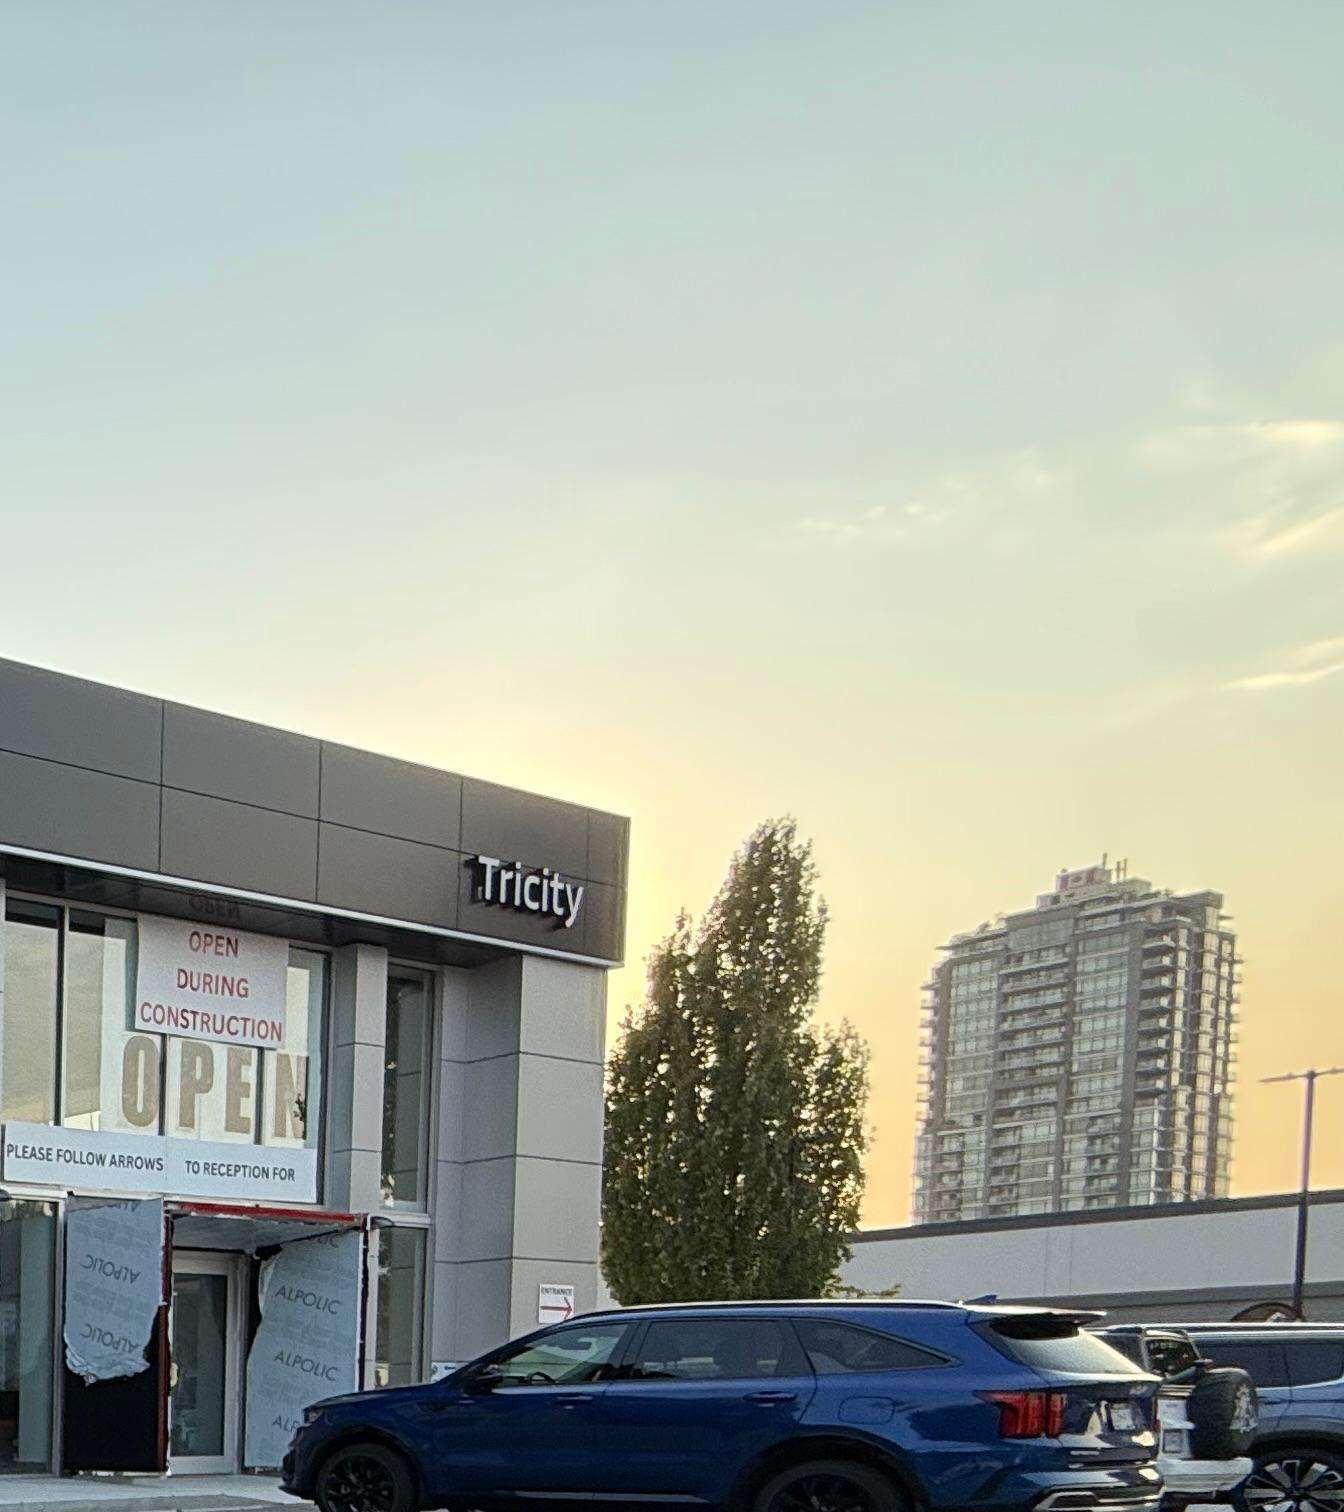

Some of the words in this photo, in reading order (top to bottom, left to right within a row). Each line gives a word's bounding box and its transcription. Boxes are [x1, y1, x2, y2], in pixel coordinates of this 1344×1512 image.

[478, 855, 584, 928] Tricity
[188, 931, 240, 959] OPEN
[176, 968, 250, 999] DURING
[140, 1002, 283, 1042] CONSTRUCTION
[121, 1035, 309, 1141] OPEN
[6, 1143, 53, 1162] PLEASE
[56, 1149, 107, 1167] FOLLOW
[109, 1154, 164, 1172] ARROWS
[185, 1160, 200, 1175] TO
[203, 1162, 269, 1180] RECEPTION
[273, 1167, 295, 1182] FOR
[82, 1254, 141, 1284] ALPOLIC
[274, 1285, 341, 1315] ALPOLIC
[273, 1351, 340, 1382] ALPOLIC
